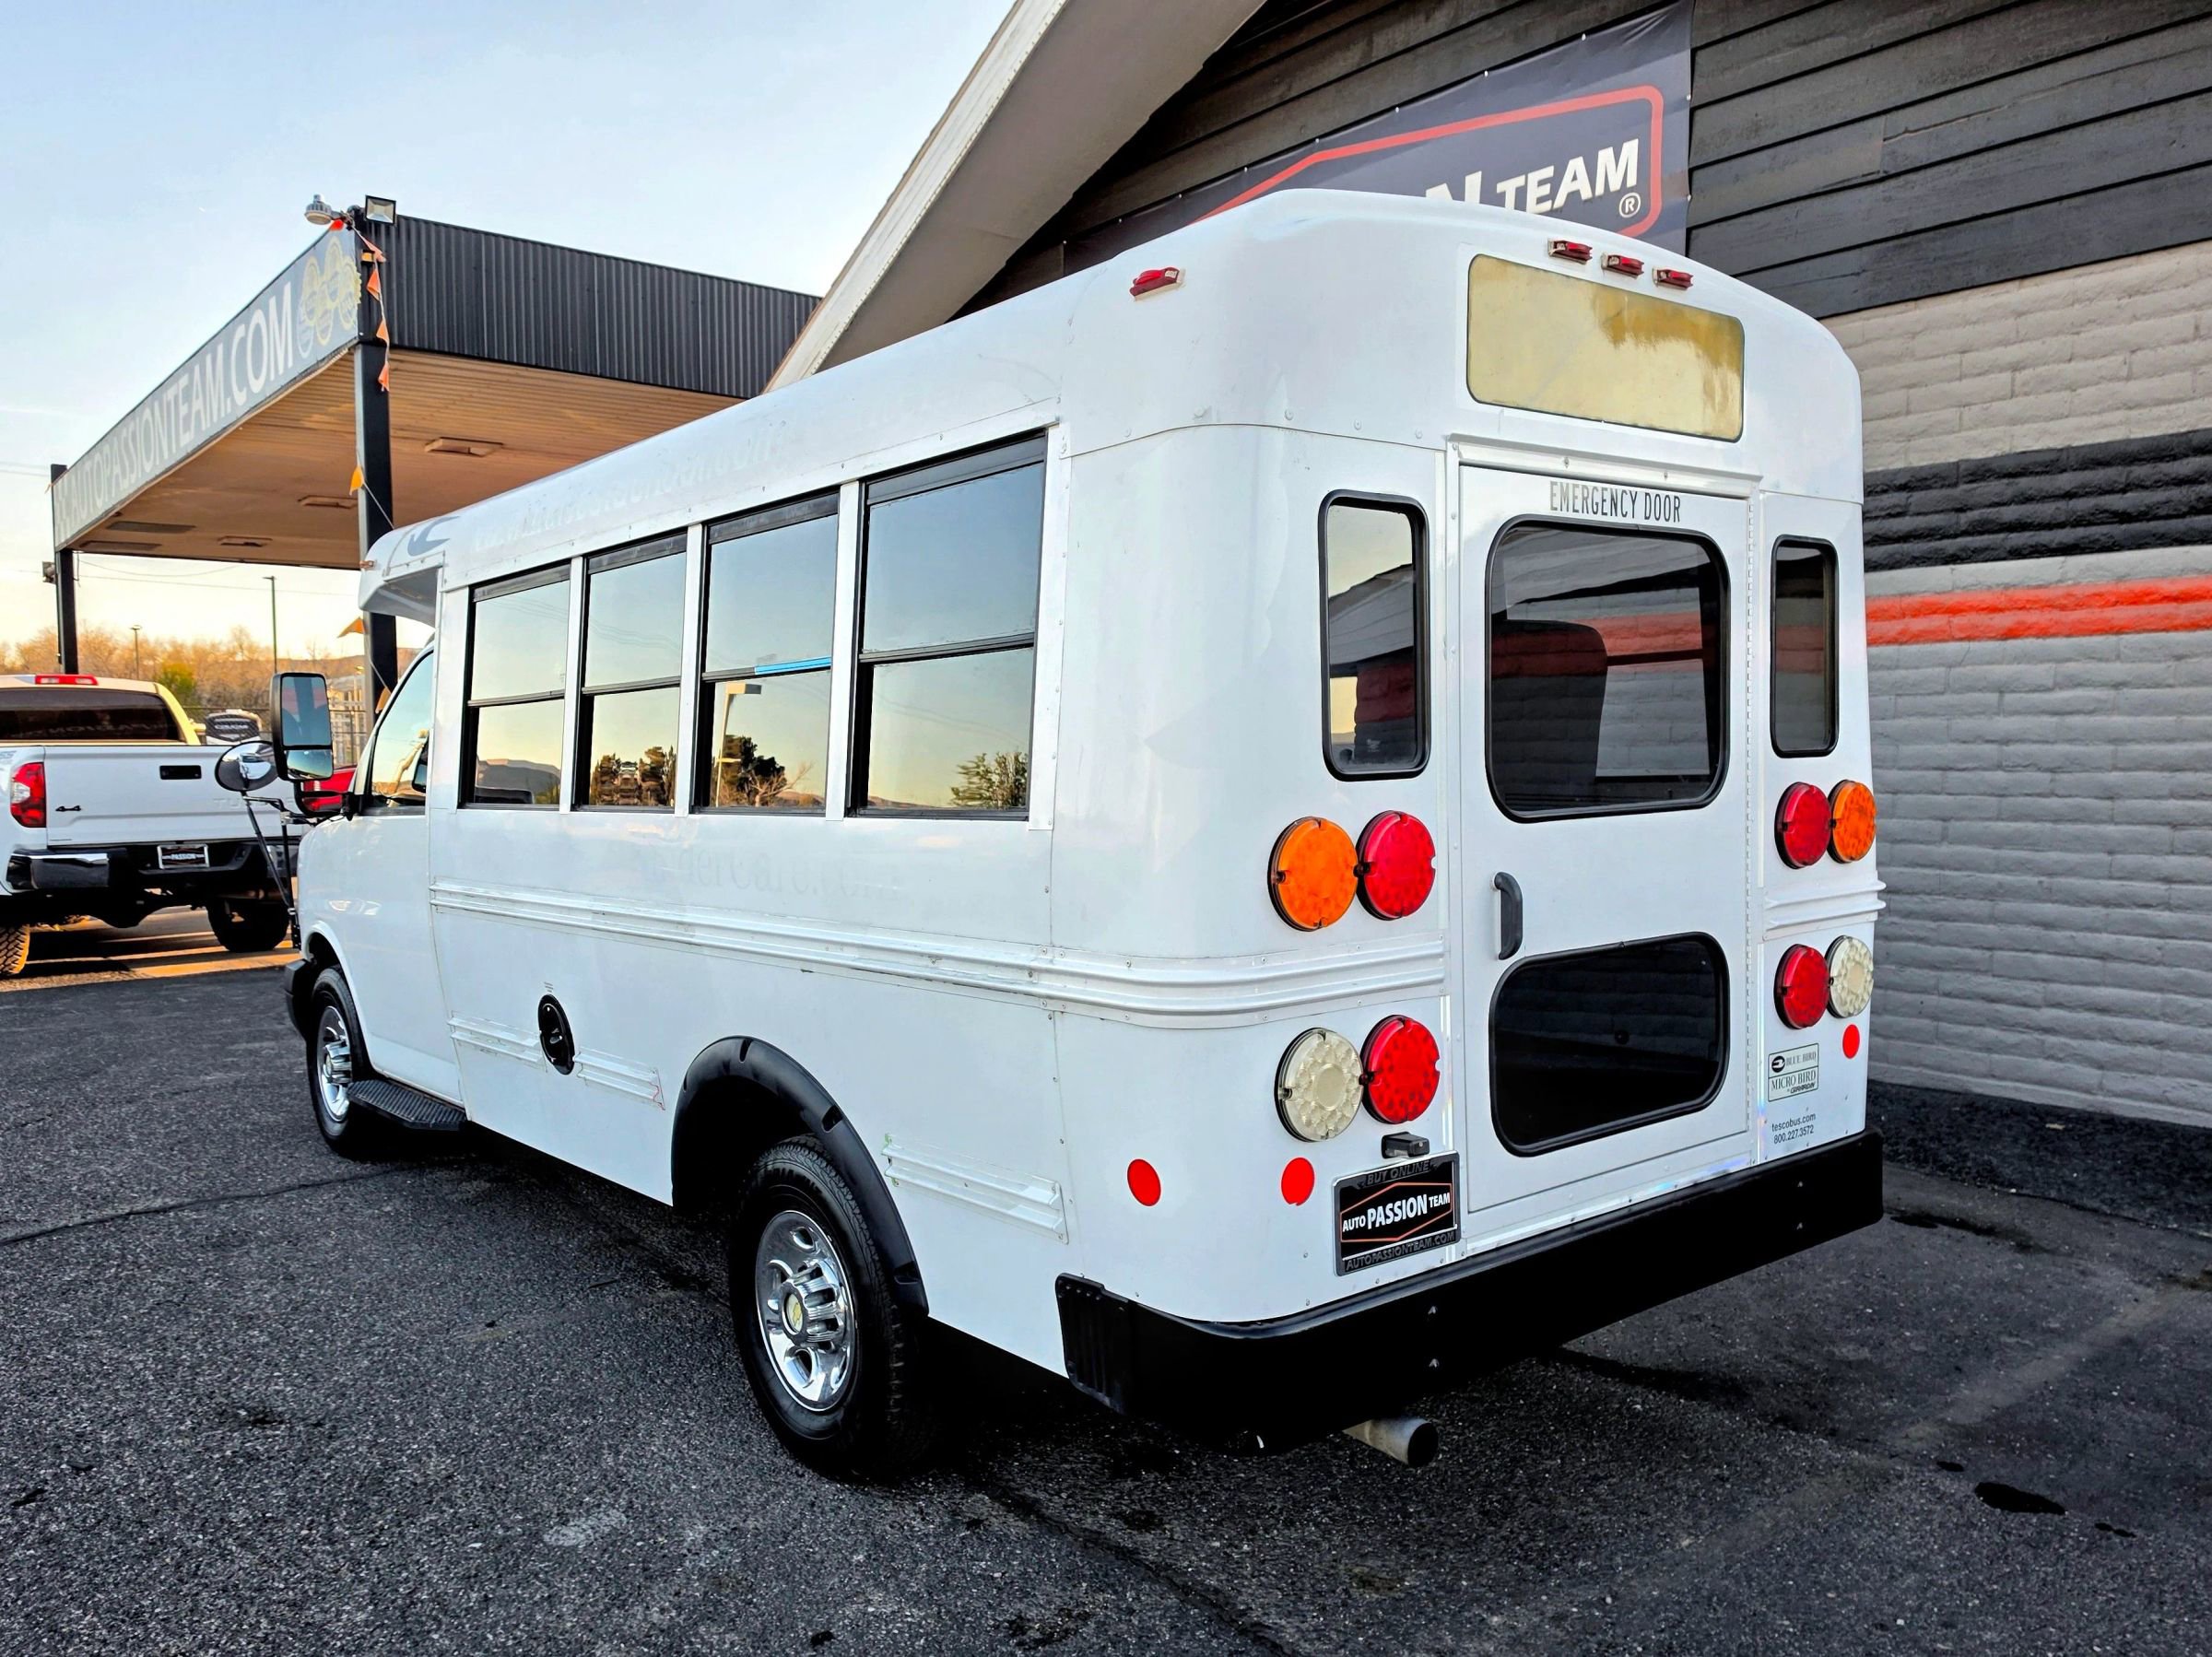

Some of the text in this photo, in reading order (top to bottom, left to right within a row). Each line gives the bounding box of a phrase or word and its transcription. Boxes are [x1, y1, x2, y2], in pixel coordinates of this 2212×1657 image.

[1496, 138, 1639, 215] TEAM
[71, 282, 295, 522] AUTOPASSIONTEAM.COM
[1549, 480, 1681, 523] EMERGENCY DOOR
[1771, 1069, 1817, 1091] MICRO BIRD
[1771, 1113, 1817, 1132] tescobus.com
[1773, 1124, 1814, 1144] 800.227.3572
[1367, 1160, 1430, 1185] BUY ONLINE
[1342, 1192, 1451, 1232] AUTO PASSION TEAM
[1346, 1232, 1454, 1271] AUTOPASSIONTEAM.COM
